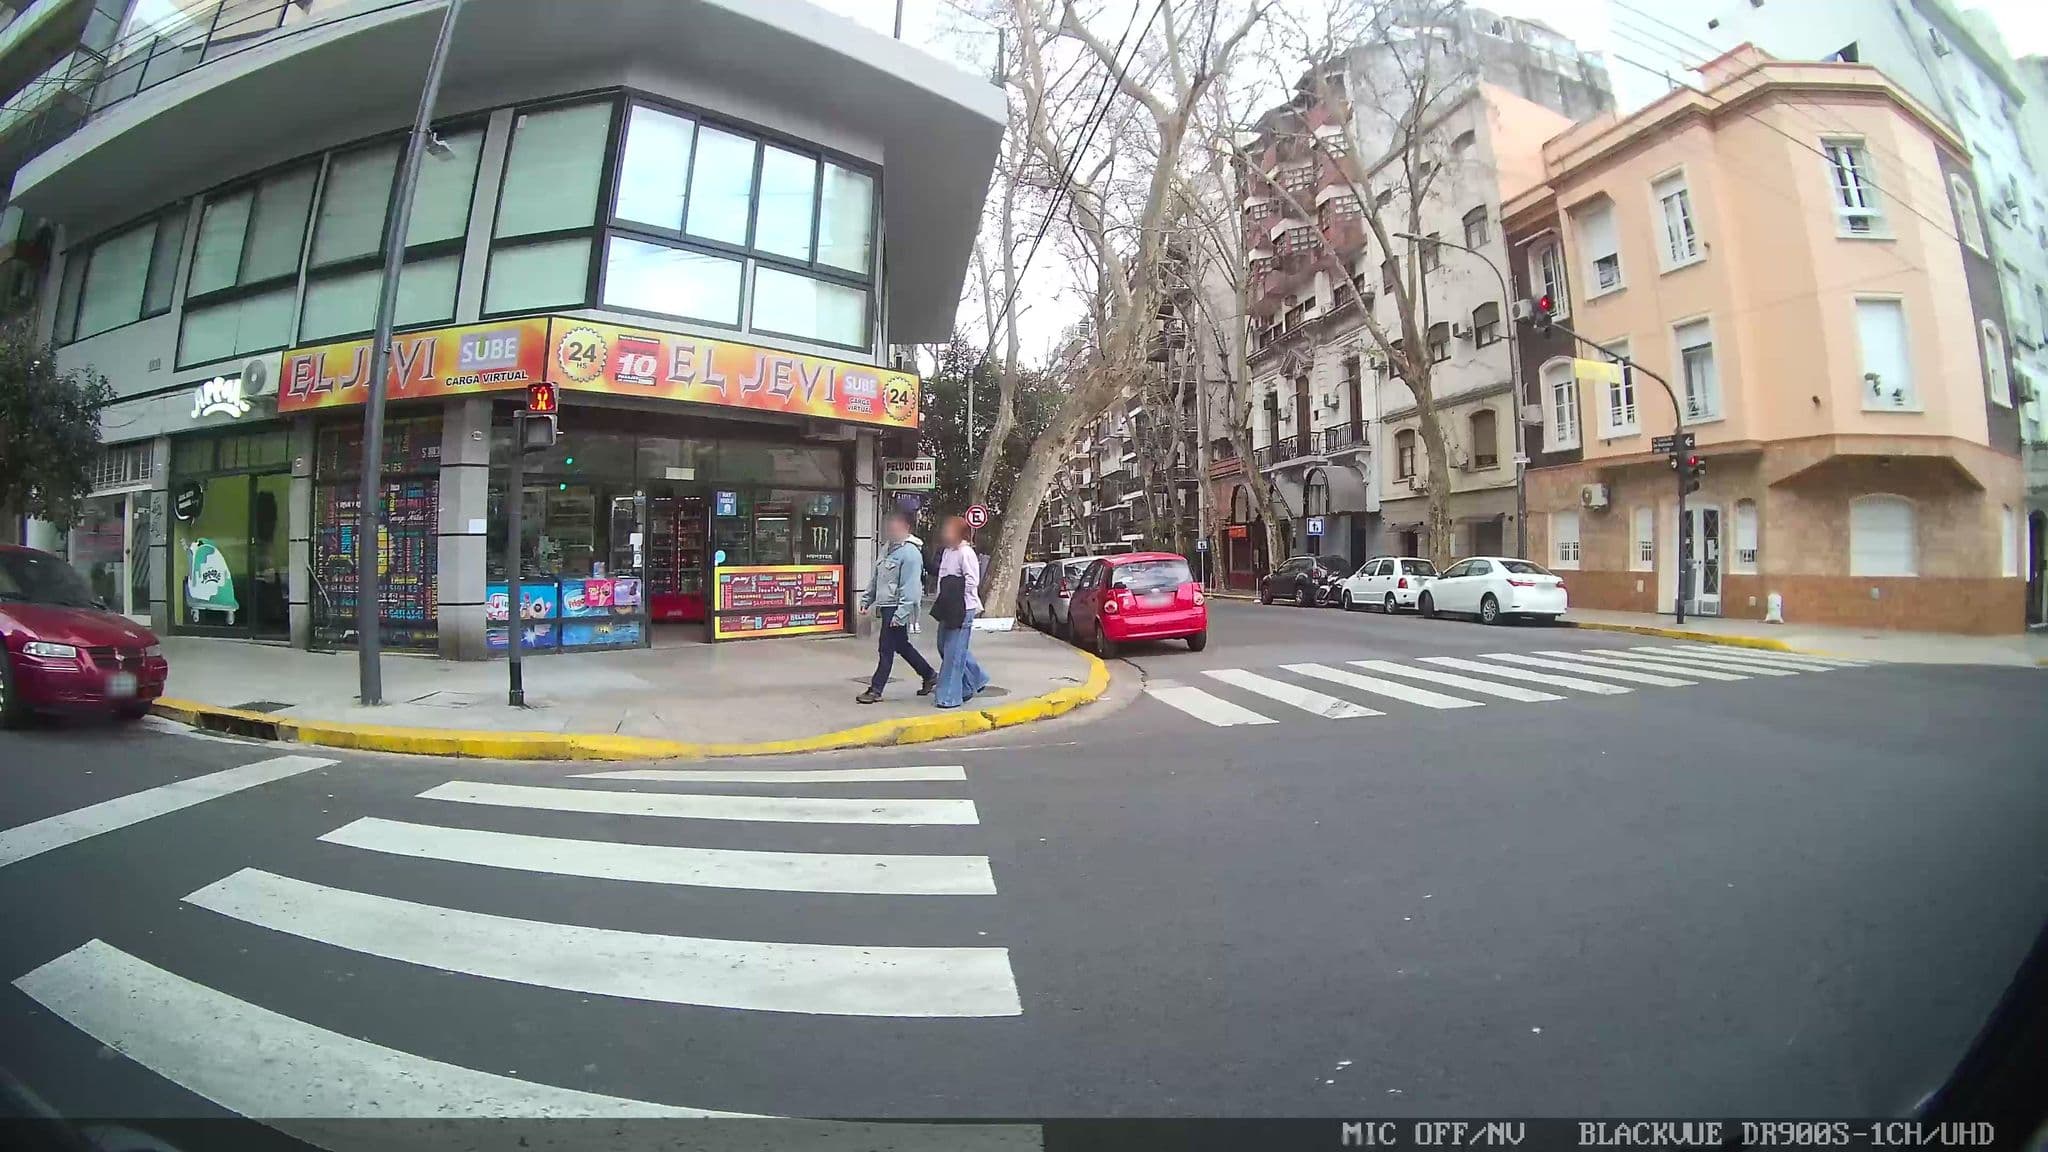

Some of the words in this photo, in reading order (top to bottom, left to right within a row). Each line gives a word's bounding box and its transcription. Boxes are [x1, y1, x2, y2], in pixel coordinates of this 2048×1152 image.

[461, 337, 518, 364] SUBE
[568, 341, 597, 363] 24
[618, 353, 657, 377] 10
[666, 343, 727, 397] EL
[738, 353, 837, 404] JEVI
[287, 351, 334, 401] EL
[445, 375, 480, 387] CARGA
[482, 370, 529, 383] VIRTUAL
[845, 375, 877, 392] SUBE
[889, 388, 909, 406] 24
[886, 461, 932, 471] PELUQUERIA
[899, 474, 932, 484] Infantil
